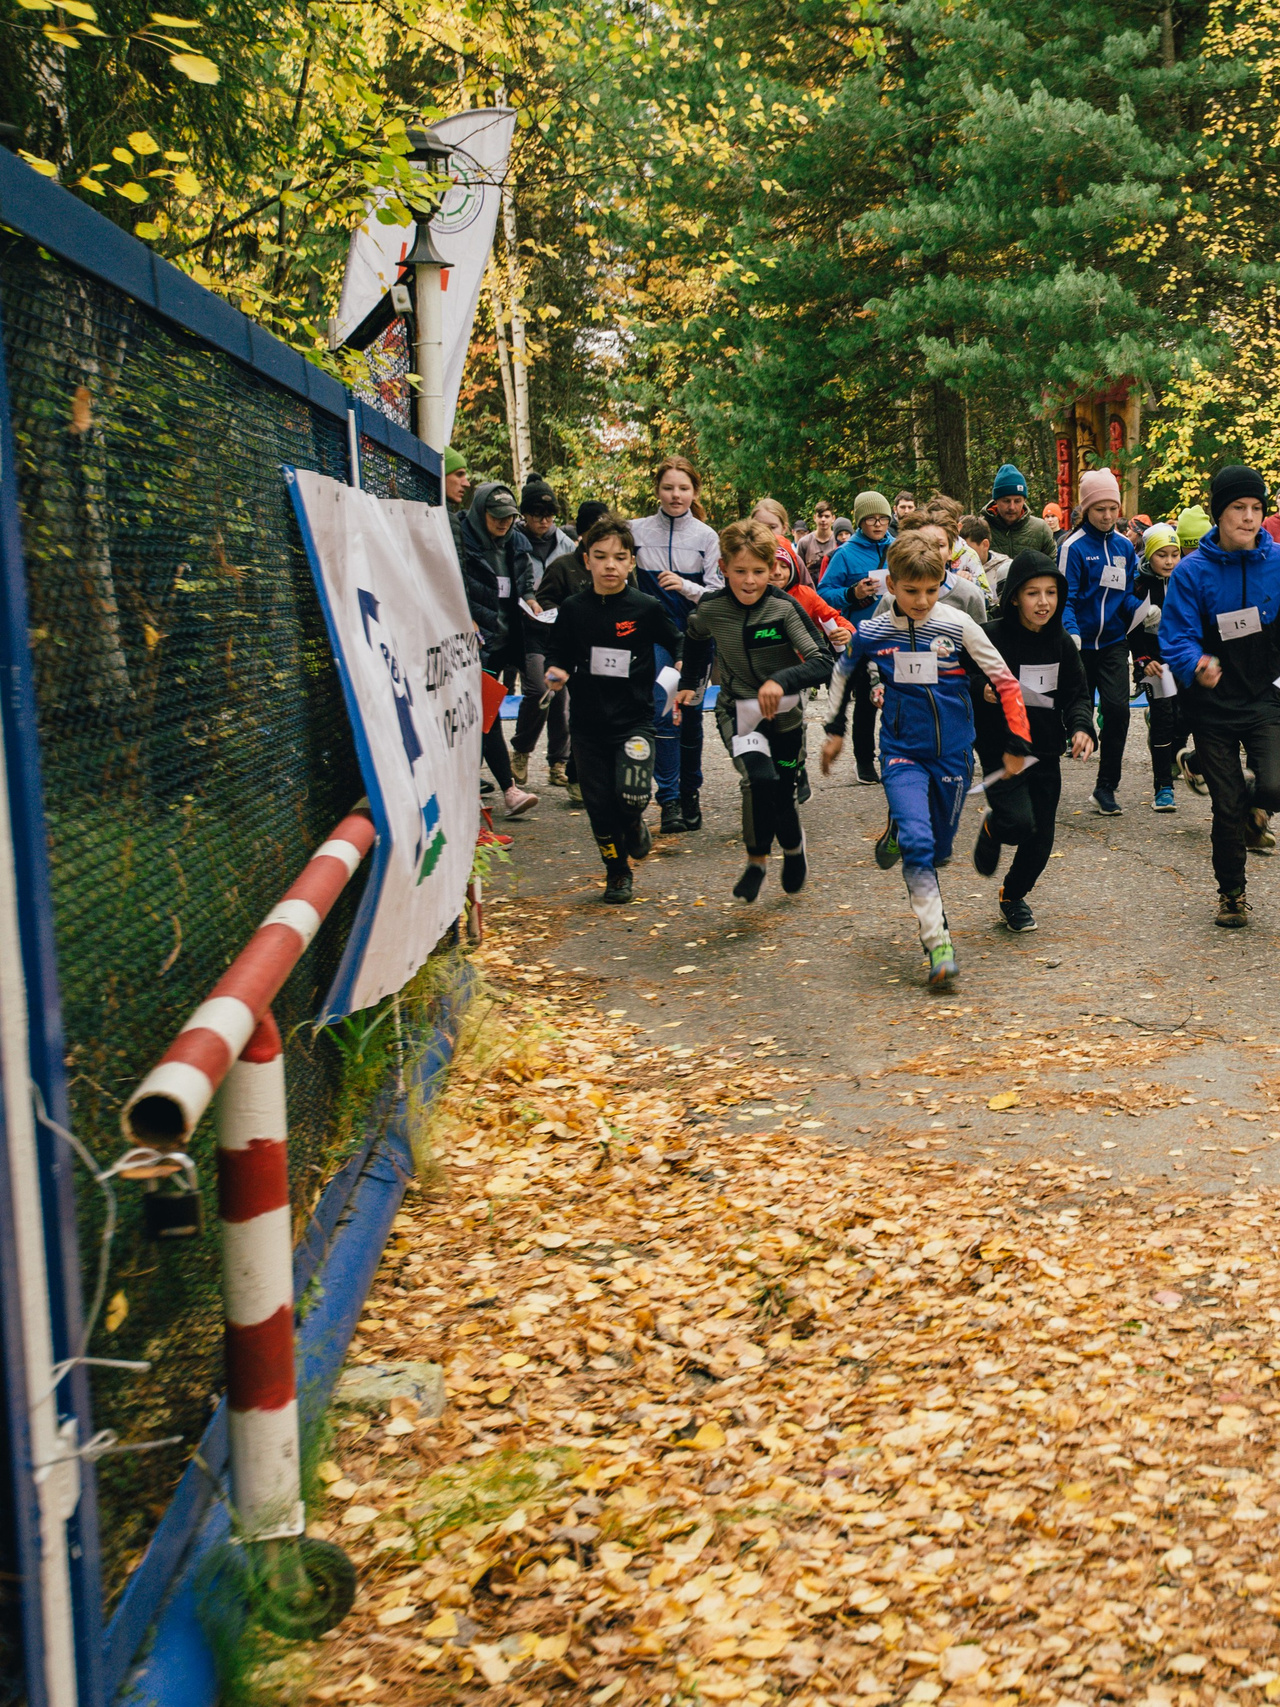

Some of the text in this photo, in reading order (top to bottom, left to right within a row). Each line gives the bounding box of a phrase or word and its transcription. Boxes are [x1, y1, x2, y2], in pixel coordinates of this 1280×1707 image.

[1234, 619, 1247, 630] 15
[754, 628, 777, 639] FILA
[604, 657, 617, 668] 22
[908, 663, 922, 674] 17
[1039, 675, 1043, 685] 1
